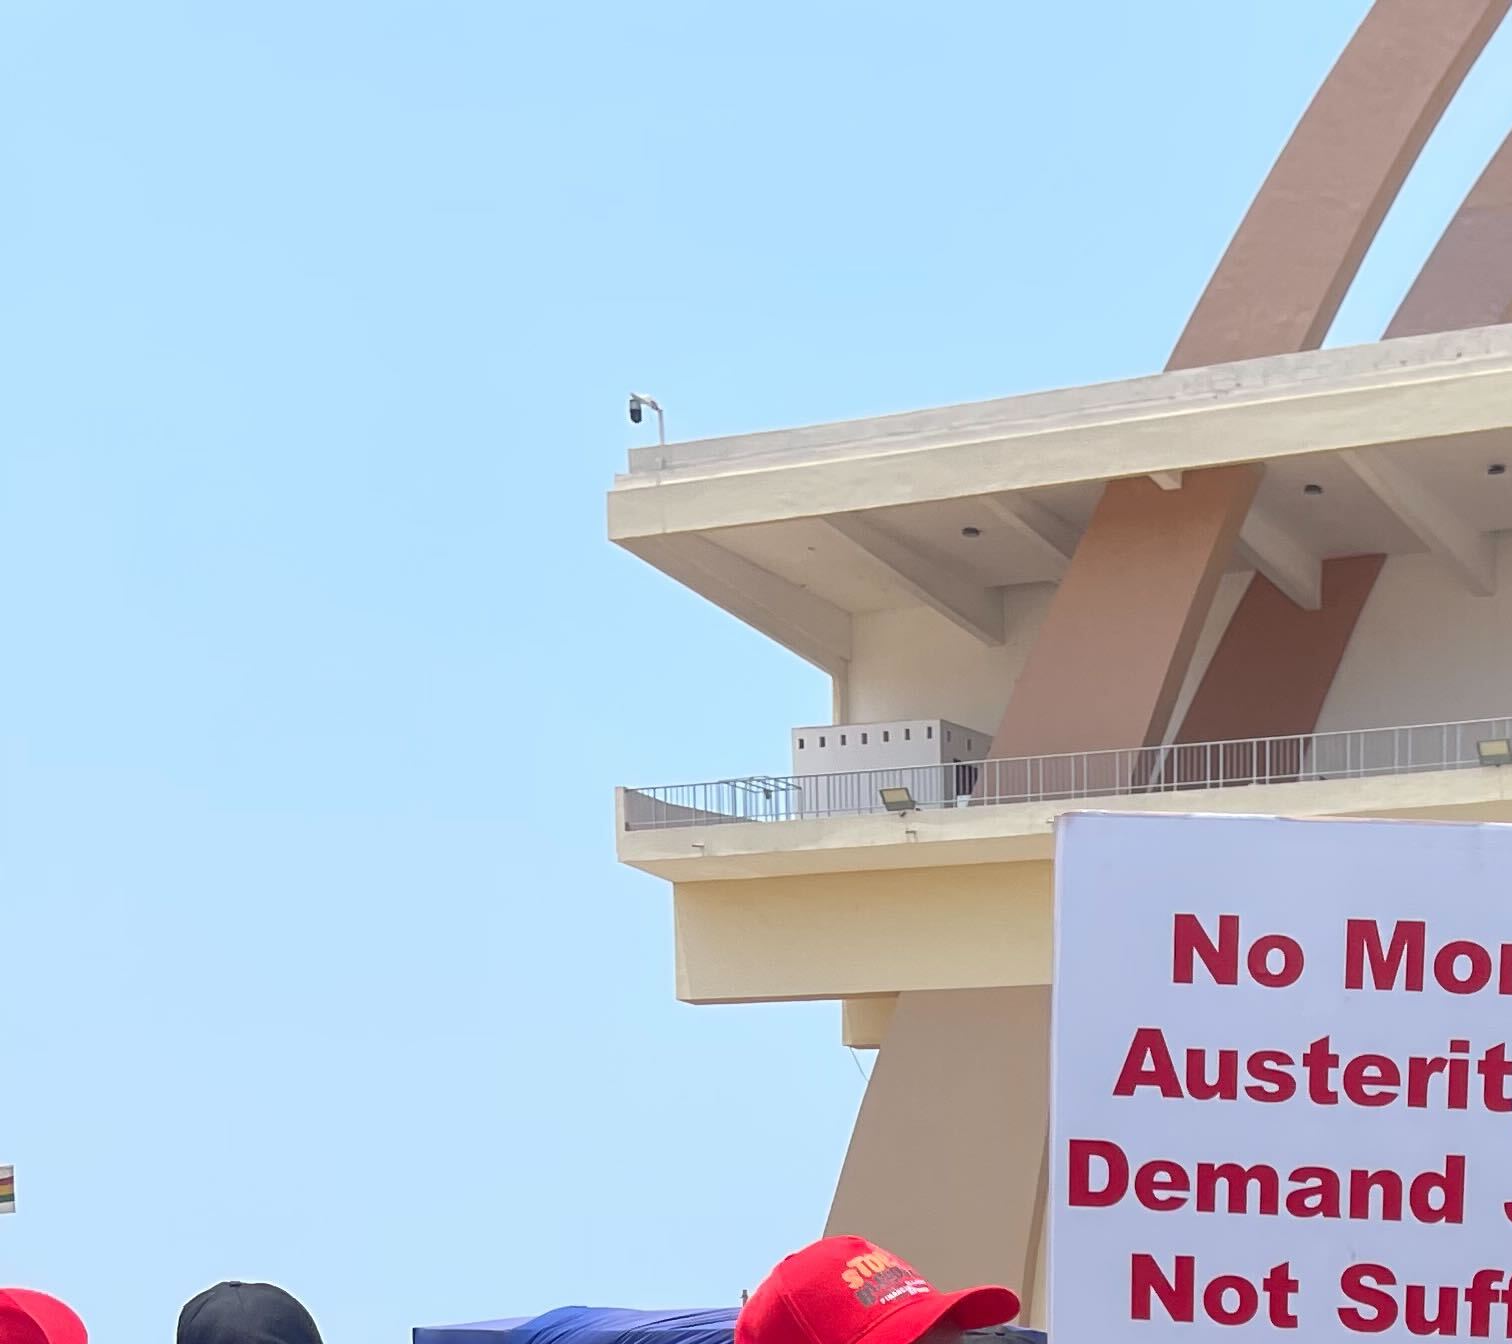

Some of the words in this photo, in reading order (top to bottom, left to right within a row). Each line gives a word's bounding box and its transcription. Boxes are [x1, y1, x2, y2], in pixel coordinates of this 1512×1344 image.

[1174, 914, 1304, 988] No
[1068, 1140, 1466, 1224] Demand
[1131, 1254, 1299, 1329] Not
